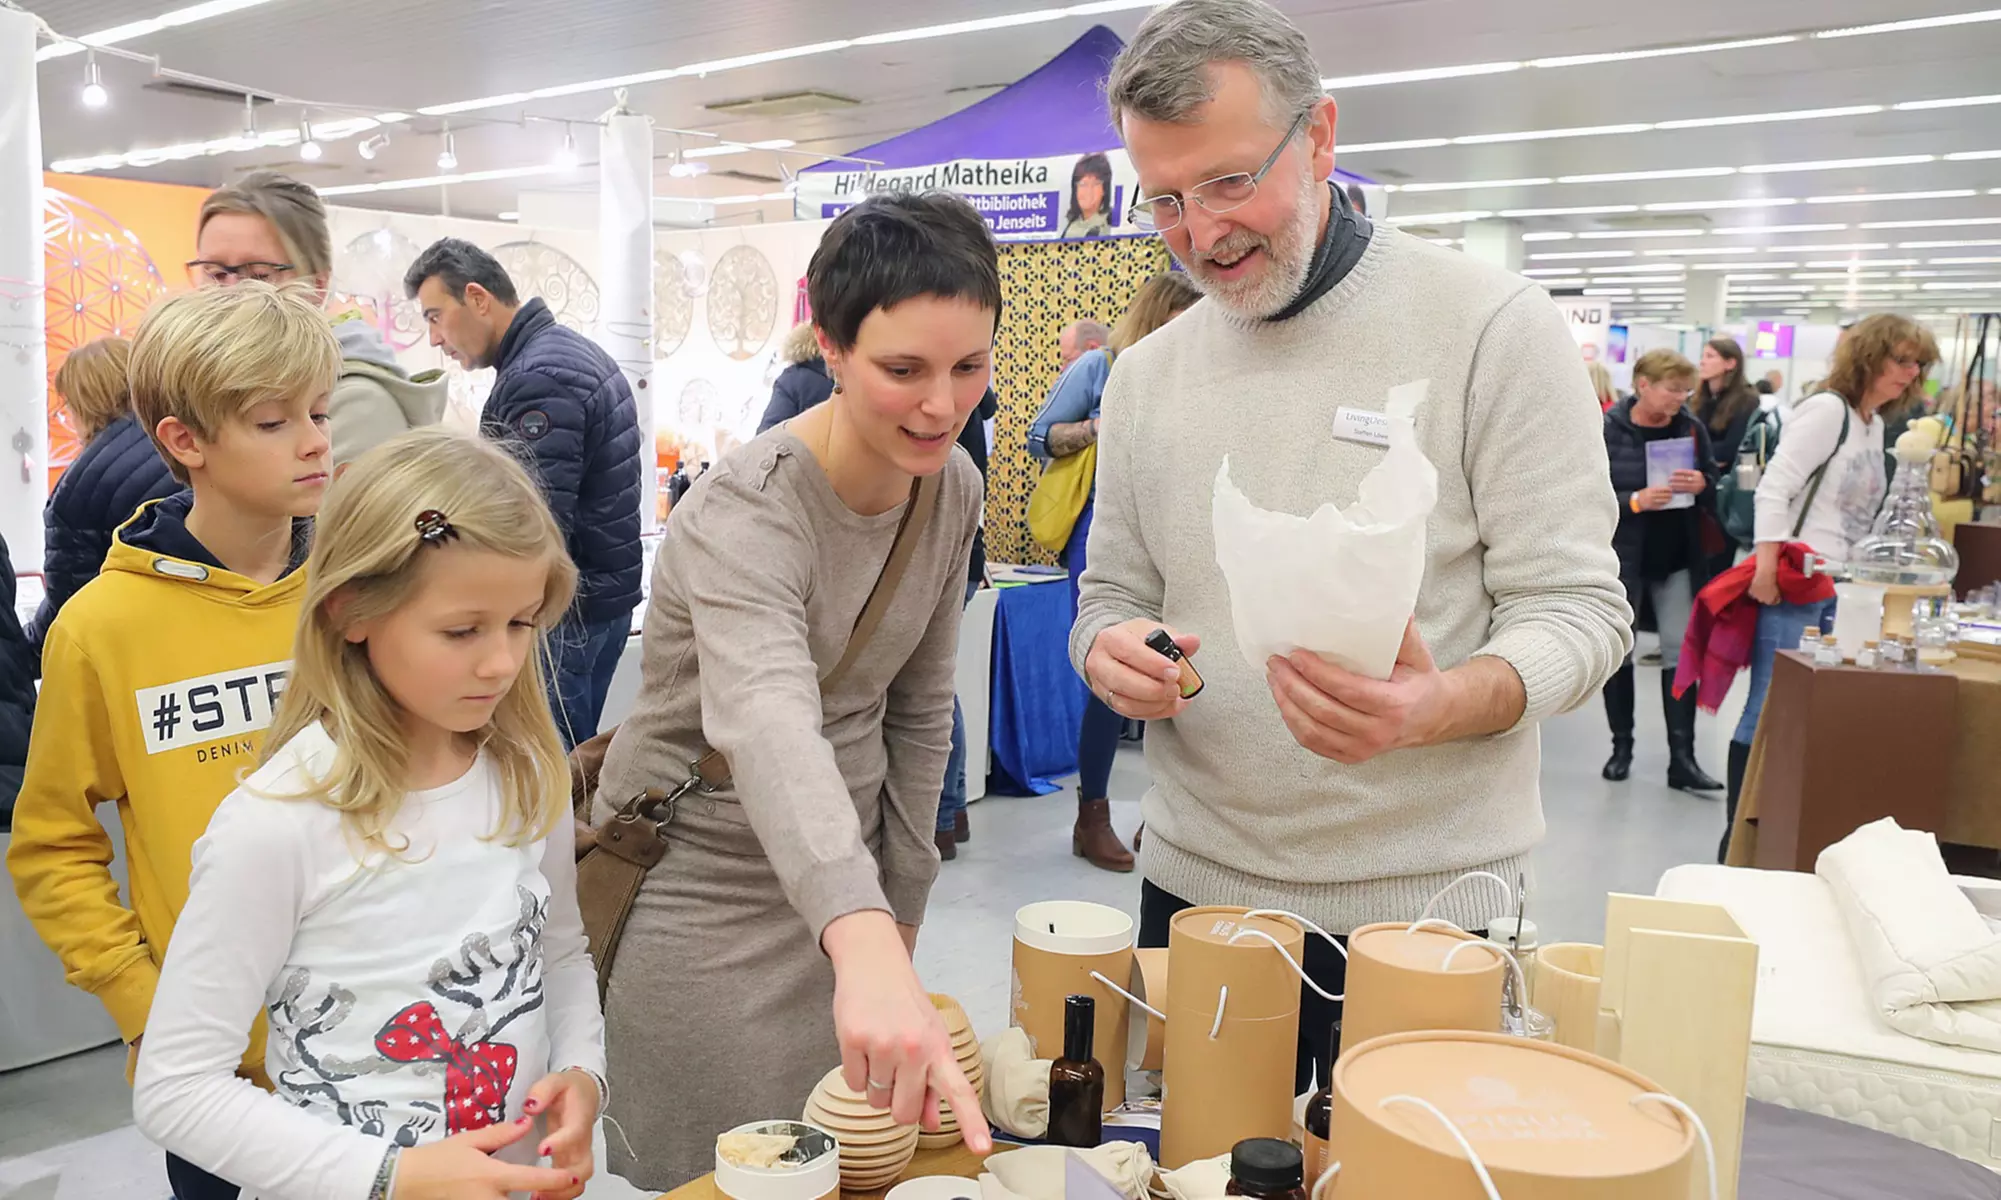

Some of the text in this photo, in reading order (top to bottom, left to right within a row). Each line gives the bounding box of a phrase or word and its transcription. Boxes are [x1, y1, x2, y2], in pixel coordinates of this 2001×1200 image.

[834, 160, 1048, 195] Hildegard Matheika
[969, 194, 1048, 211] ttbibliothek
[996, 214, 1047, 230] Jenseits
[197, 741, 254, 763] DENIM
